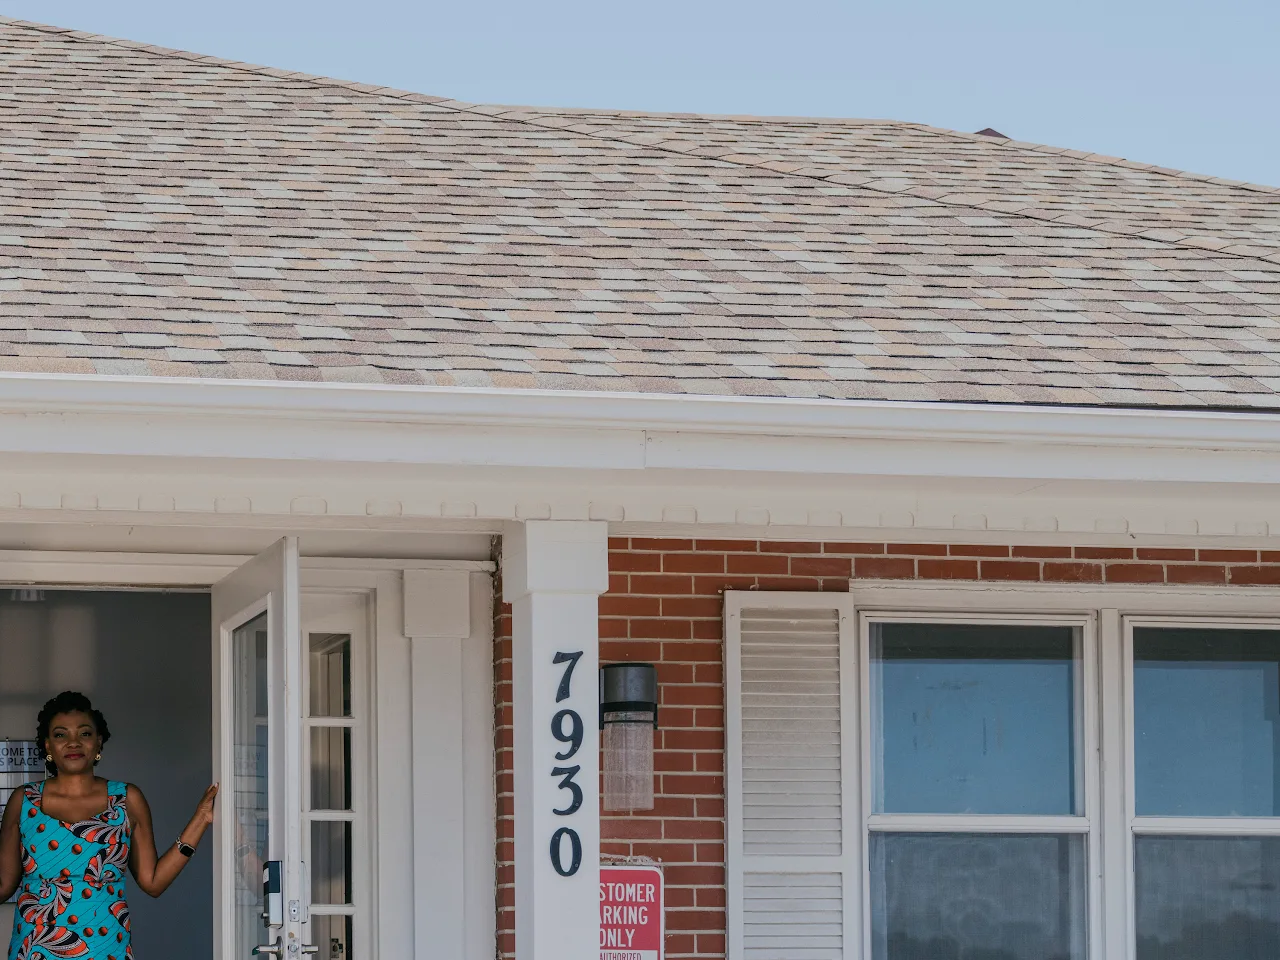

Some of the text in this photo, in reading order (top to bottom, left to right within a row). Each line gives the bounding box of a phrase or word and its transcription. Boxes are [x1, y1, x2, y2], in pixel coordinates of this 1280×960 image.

[27, 747, 41, 757] TO
[550, 651, 584, 877] 7930
[600, 905, 648, 925] RKING
[600, 928, 635, 947] ONLY
